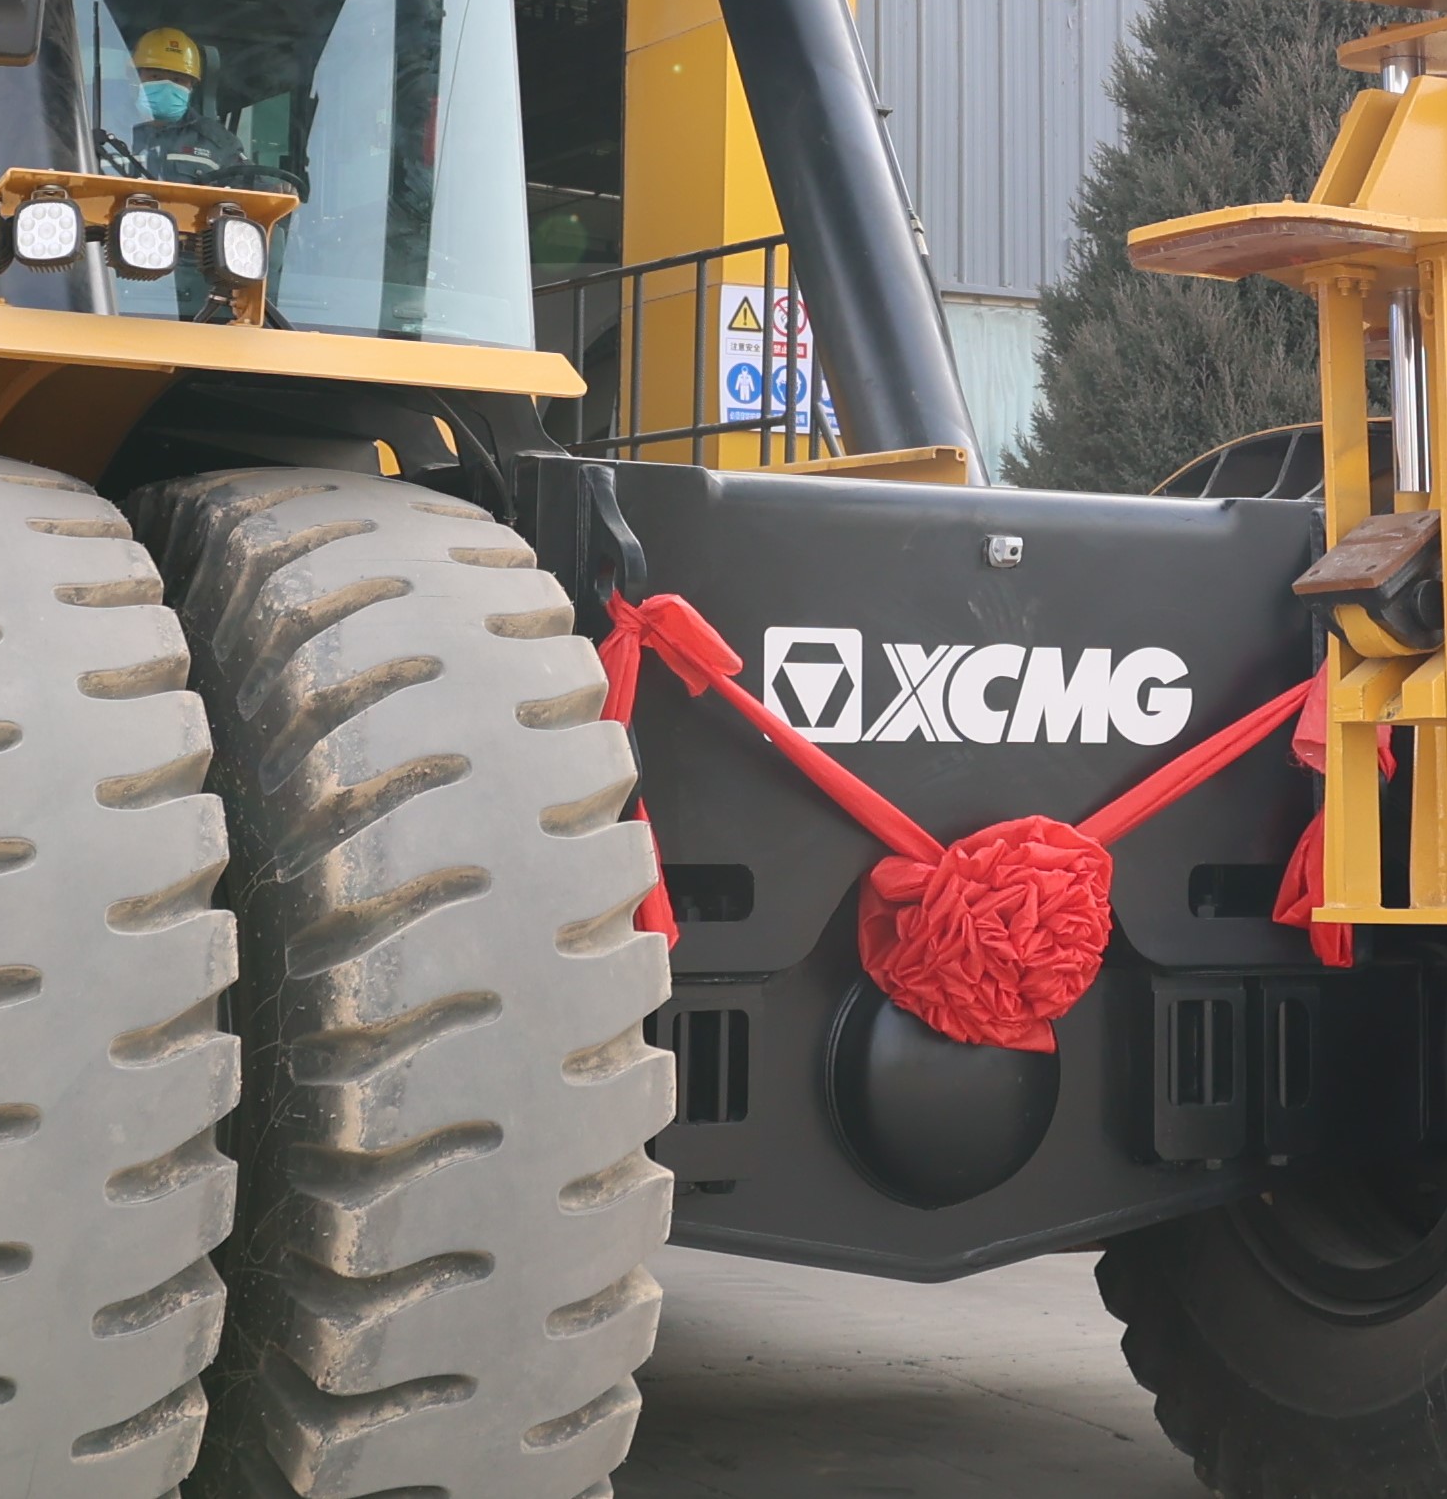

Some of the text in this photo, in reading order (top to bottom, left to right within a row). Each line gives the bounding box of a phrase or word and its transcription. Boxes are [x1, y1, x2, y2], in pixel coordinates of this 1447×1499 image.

[729, 342, 761, 352] 注意安全
[861, 643, 1193, 746] XCMG
